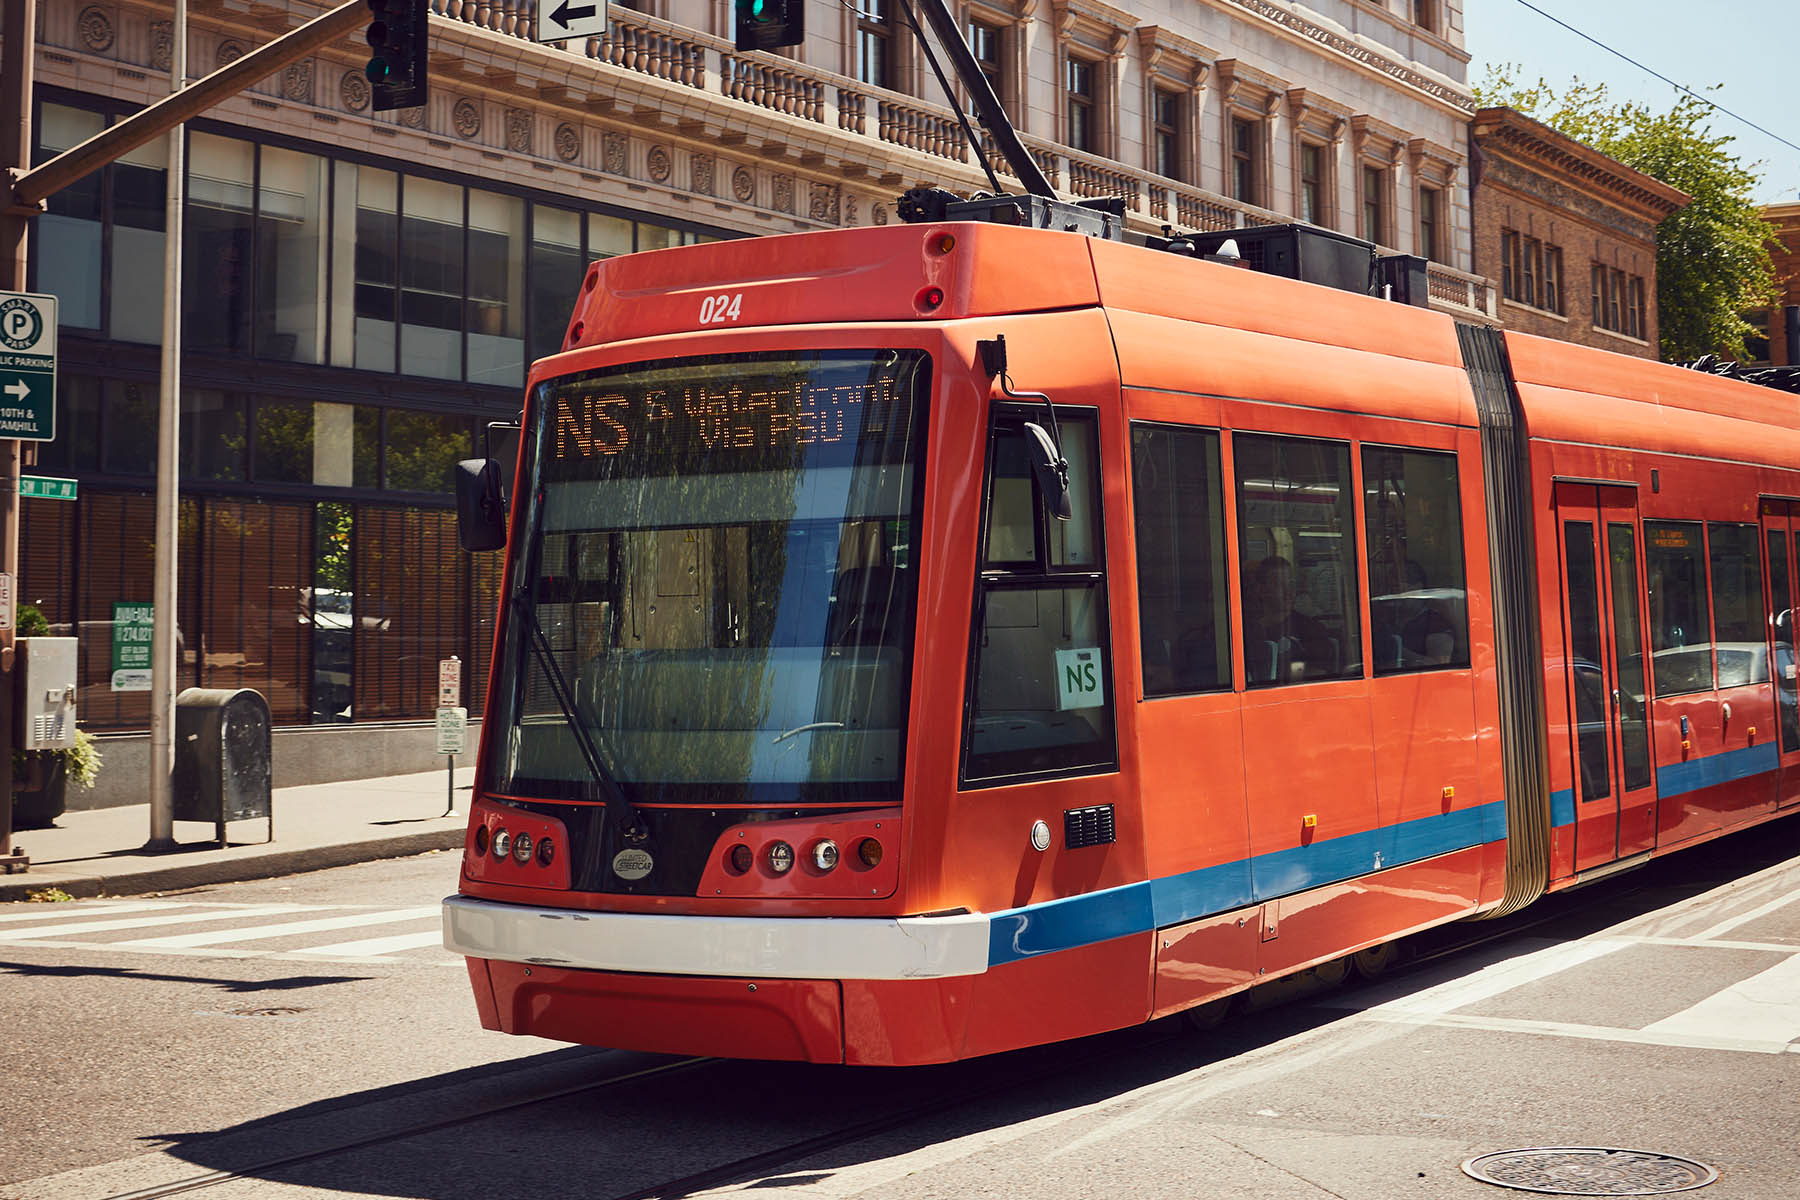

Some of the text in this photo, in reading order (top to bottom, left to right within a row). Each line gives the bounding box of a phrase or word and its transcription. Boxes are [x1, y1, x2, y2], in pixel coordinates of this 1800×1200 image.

[0, 299, 36, 314] SMART
[699, 293, 743, 324] 024
[13, 314, 26, 334] P
[5, 337, 32, 349] PARK
[15, 356, 54, 369] PARKING
[1, 408, 34, 419] 10TH &
[557, 395, 629, 457] NS
[700, 410, 842, 448] Via PSU
[1066, 663, 1096, 693] NS
